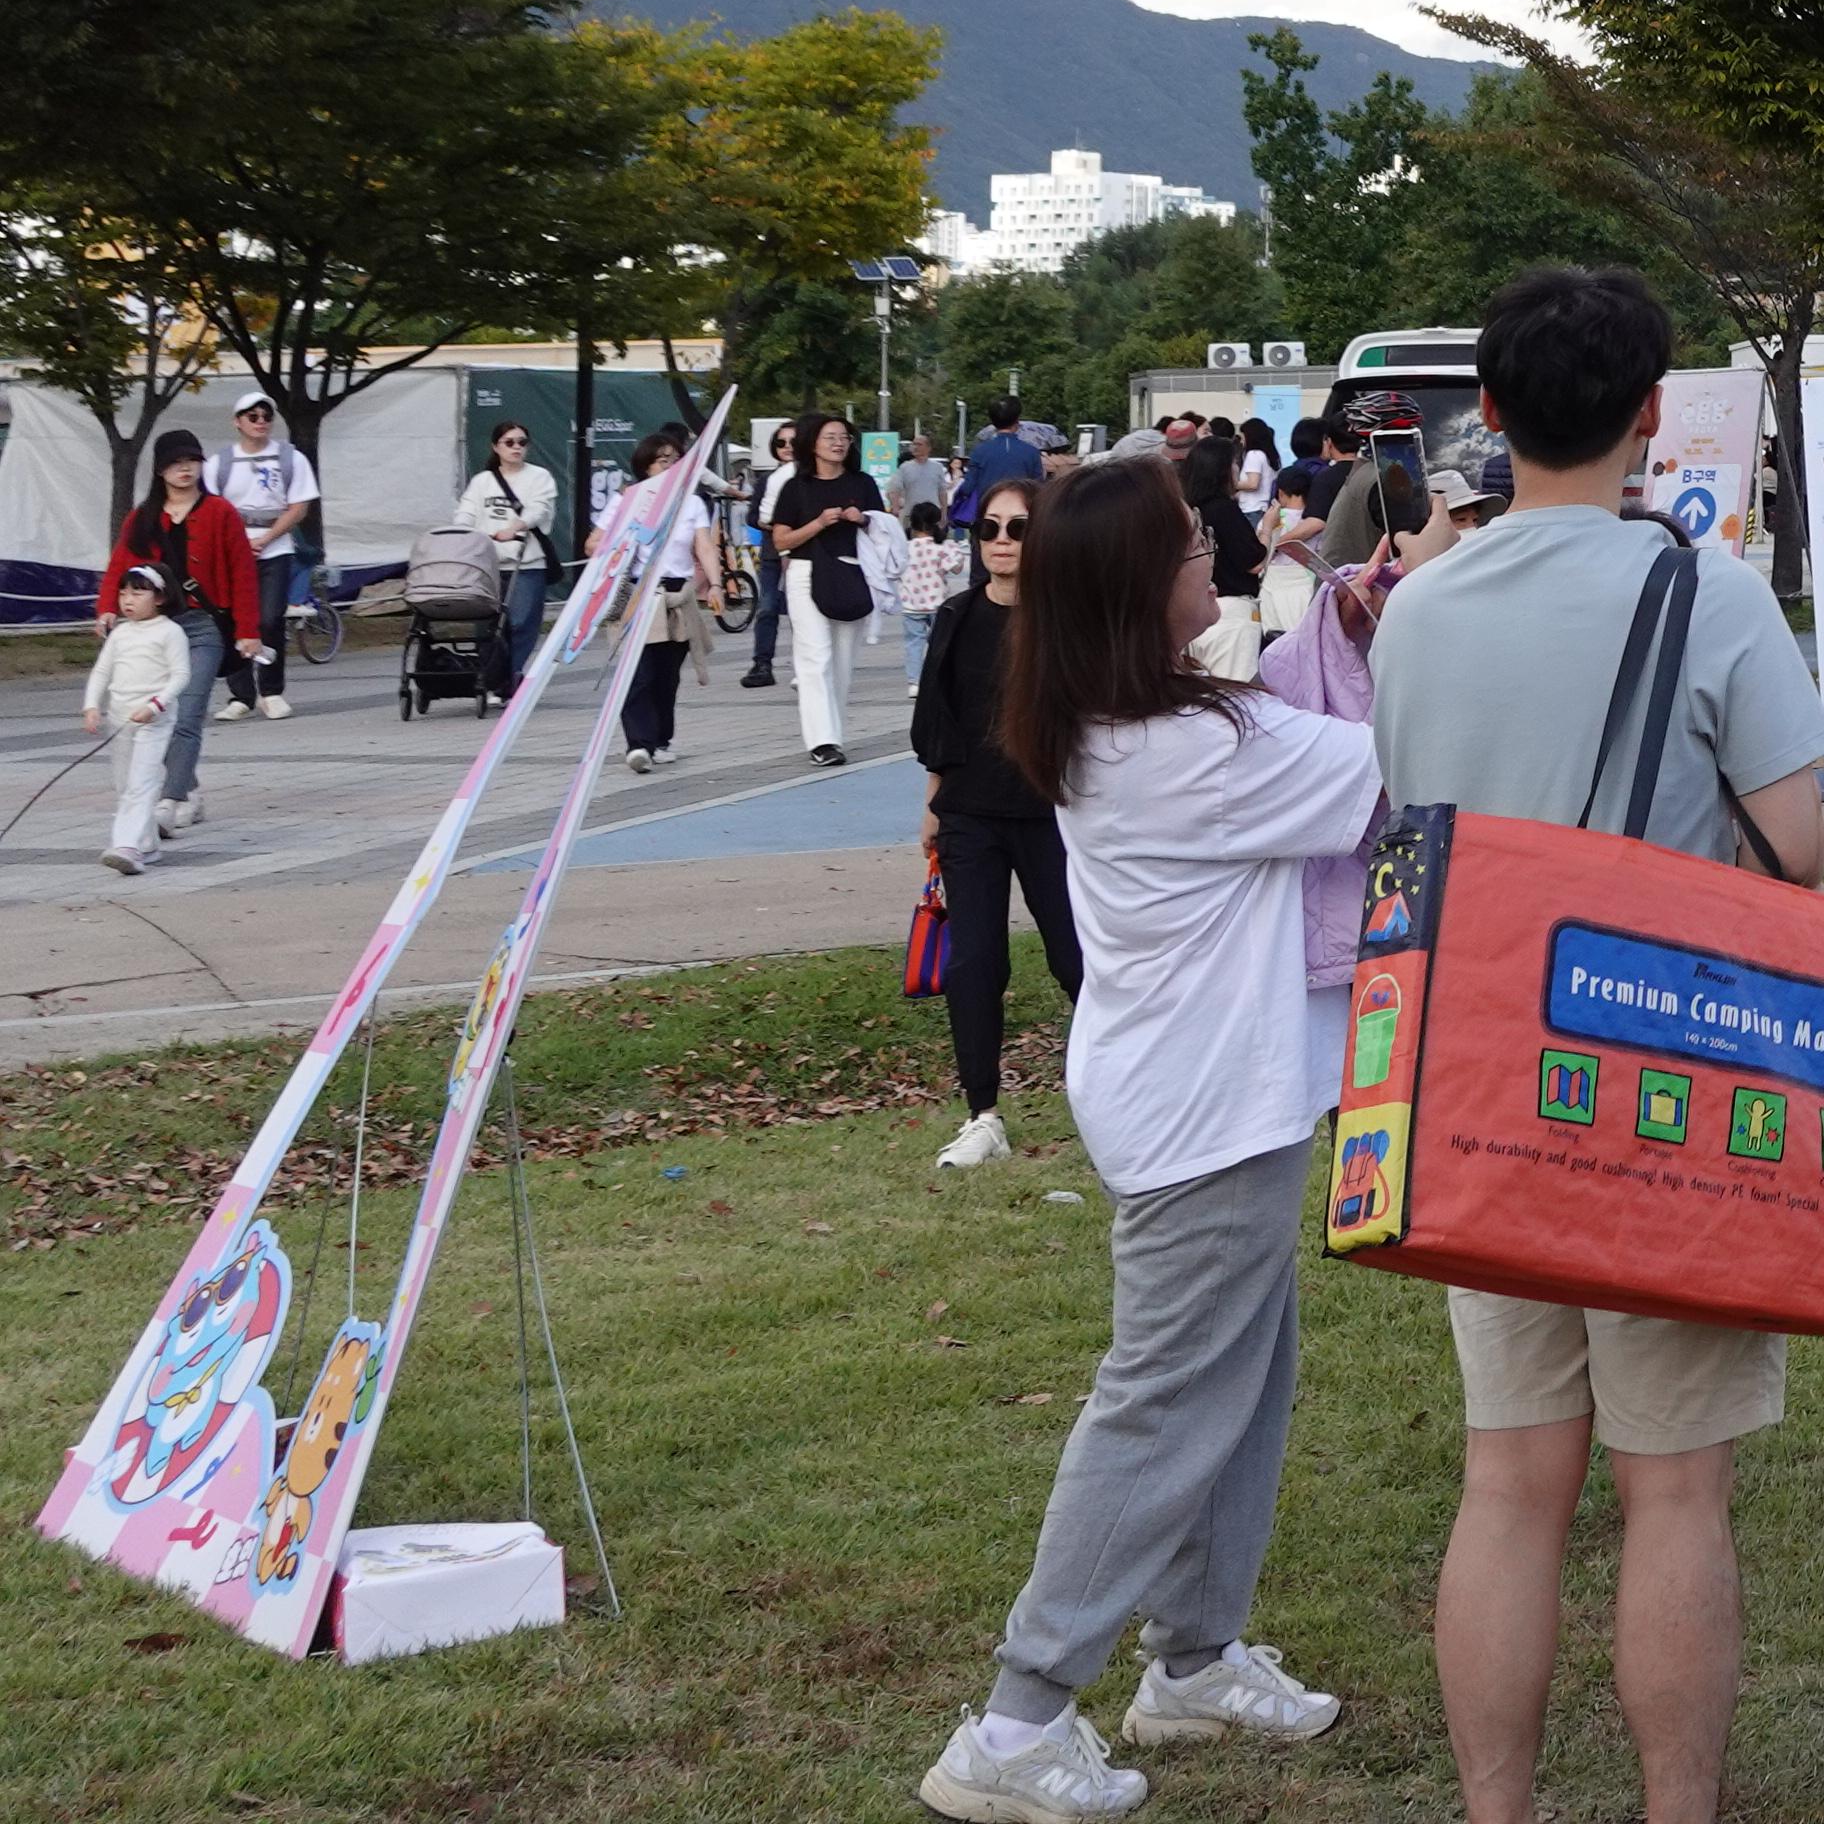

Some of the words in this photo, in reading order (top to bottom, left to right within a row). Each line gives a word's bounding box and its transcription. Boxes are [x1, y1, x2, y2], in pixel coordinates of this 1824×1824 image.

[1682, 469, 1717, 484] B구역
[1571, 965, 1678, 1016] Premium
[1690, 993, 1783, 1044] Camping
[1451, 1134, 1480, 1156] High
[1486, 1139, 1542, 1164] durability
[1546, 1150, 1566, 1166] and
[1570, 1156, 1598, 1172] good
[1602, 1161, 1658, 1186] cushioning!
[1662, 1171, 1684, 1192] High
[1690, 1178, 1726, 1199] density
[1732, 1183, 1744, 1198] PE
[1750, 1186, 1782, 1205] foam!
[1785, 1192, 1819, 1212] Special
